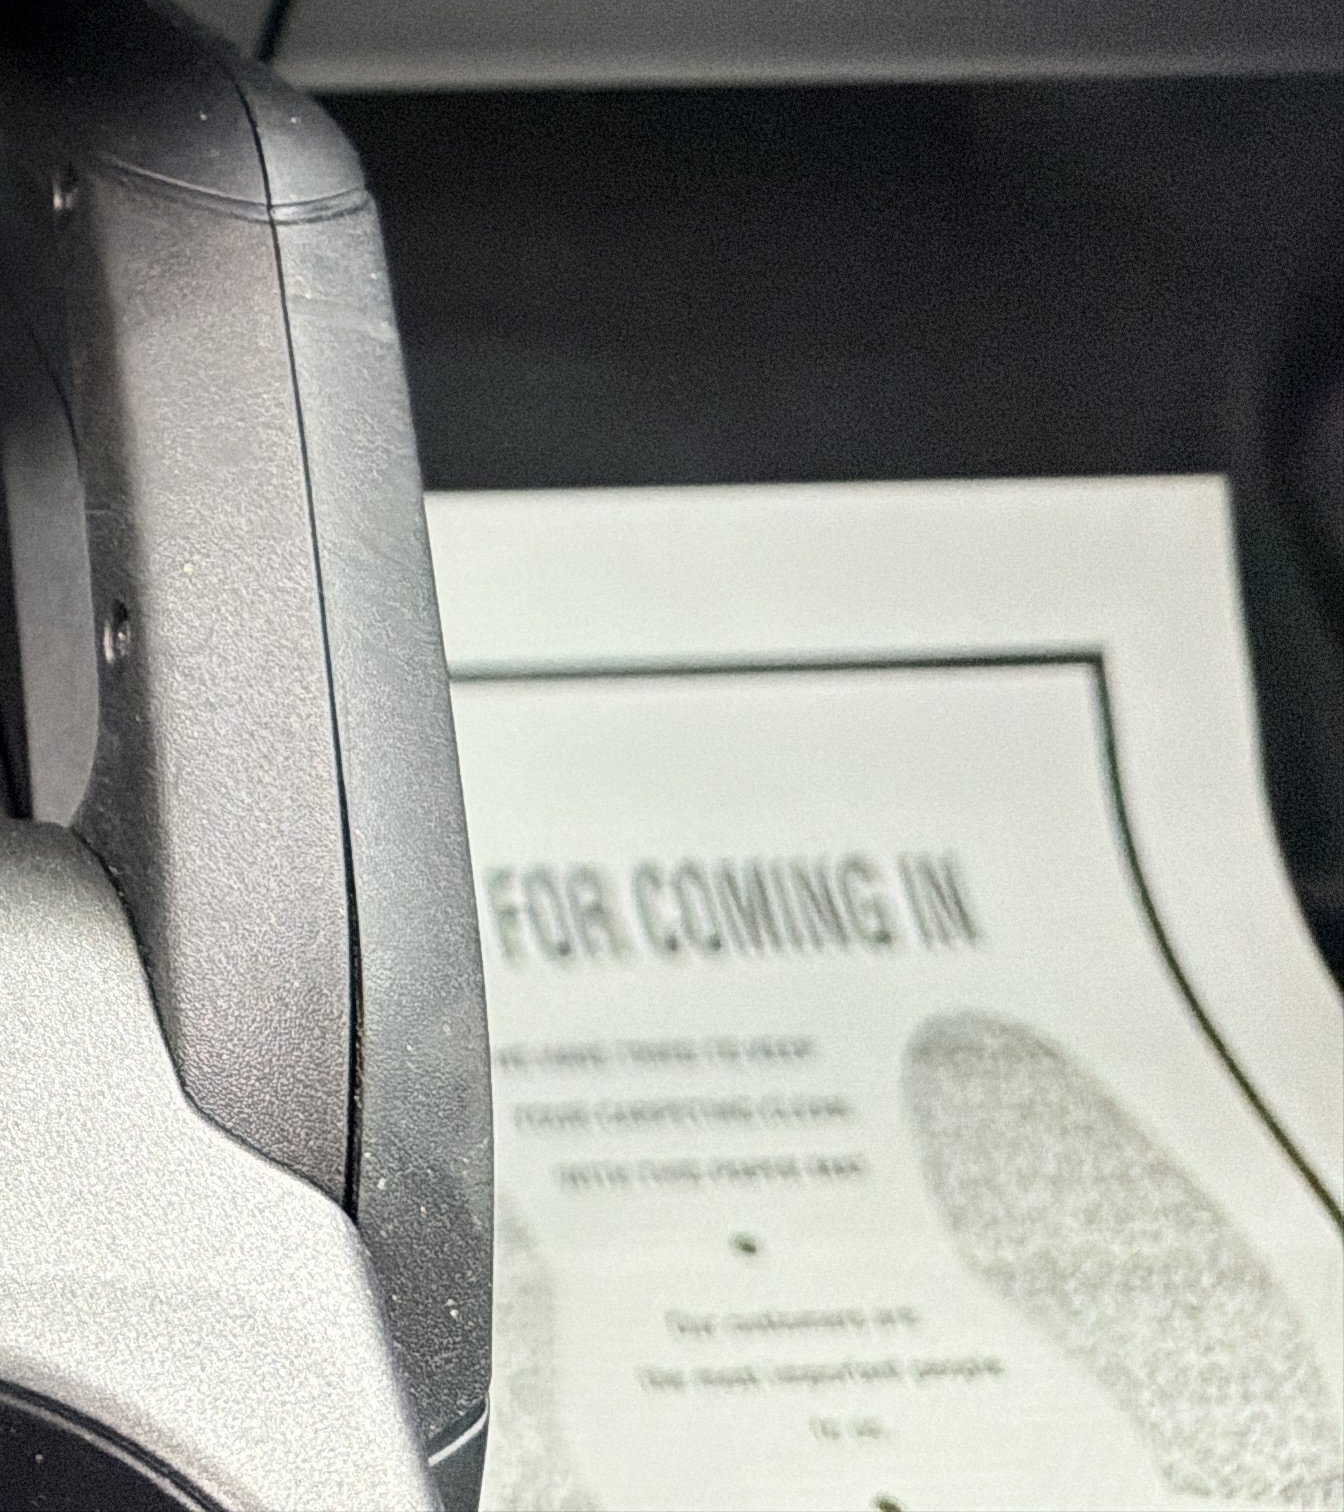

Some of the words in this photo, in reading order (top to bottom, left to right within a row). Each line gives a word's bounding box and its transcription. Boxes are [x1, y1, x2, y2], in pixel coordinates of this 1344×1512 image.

[484, 862, 630, 964] FOR
[631, 854, 895, 958] COMING
[898, 851, 984, 952] IN
